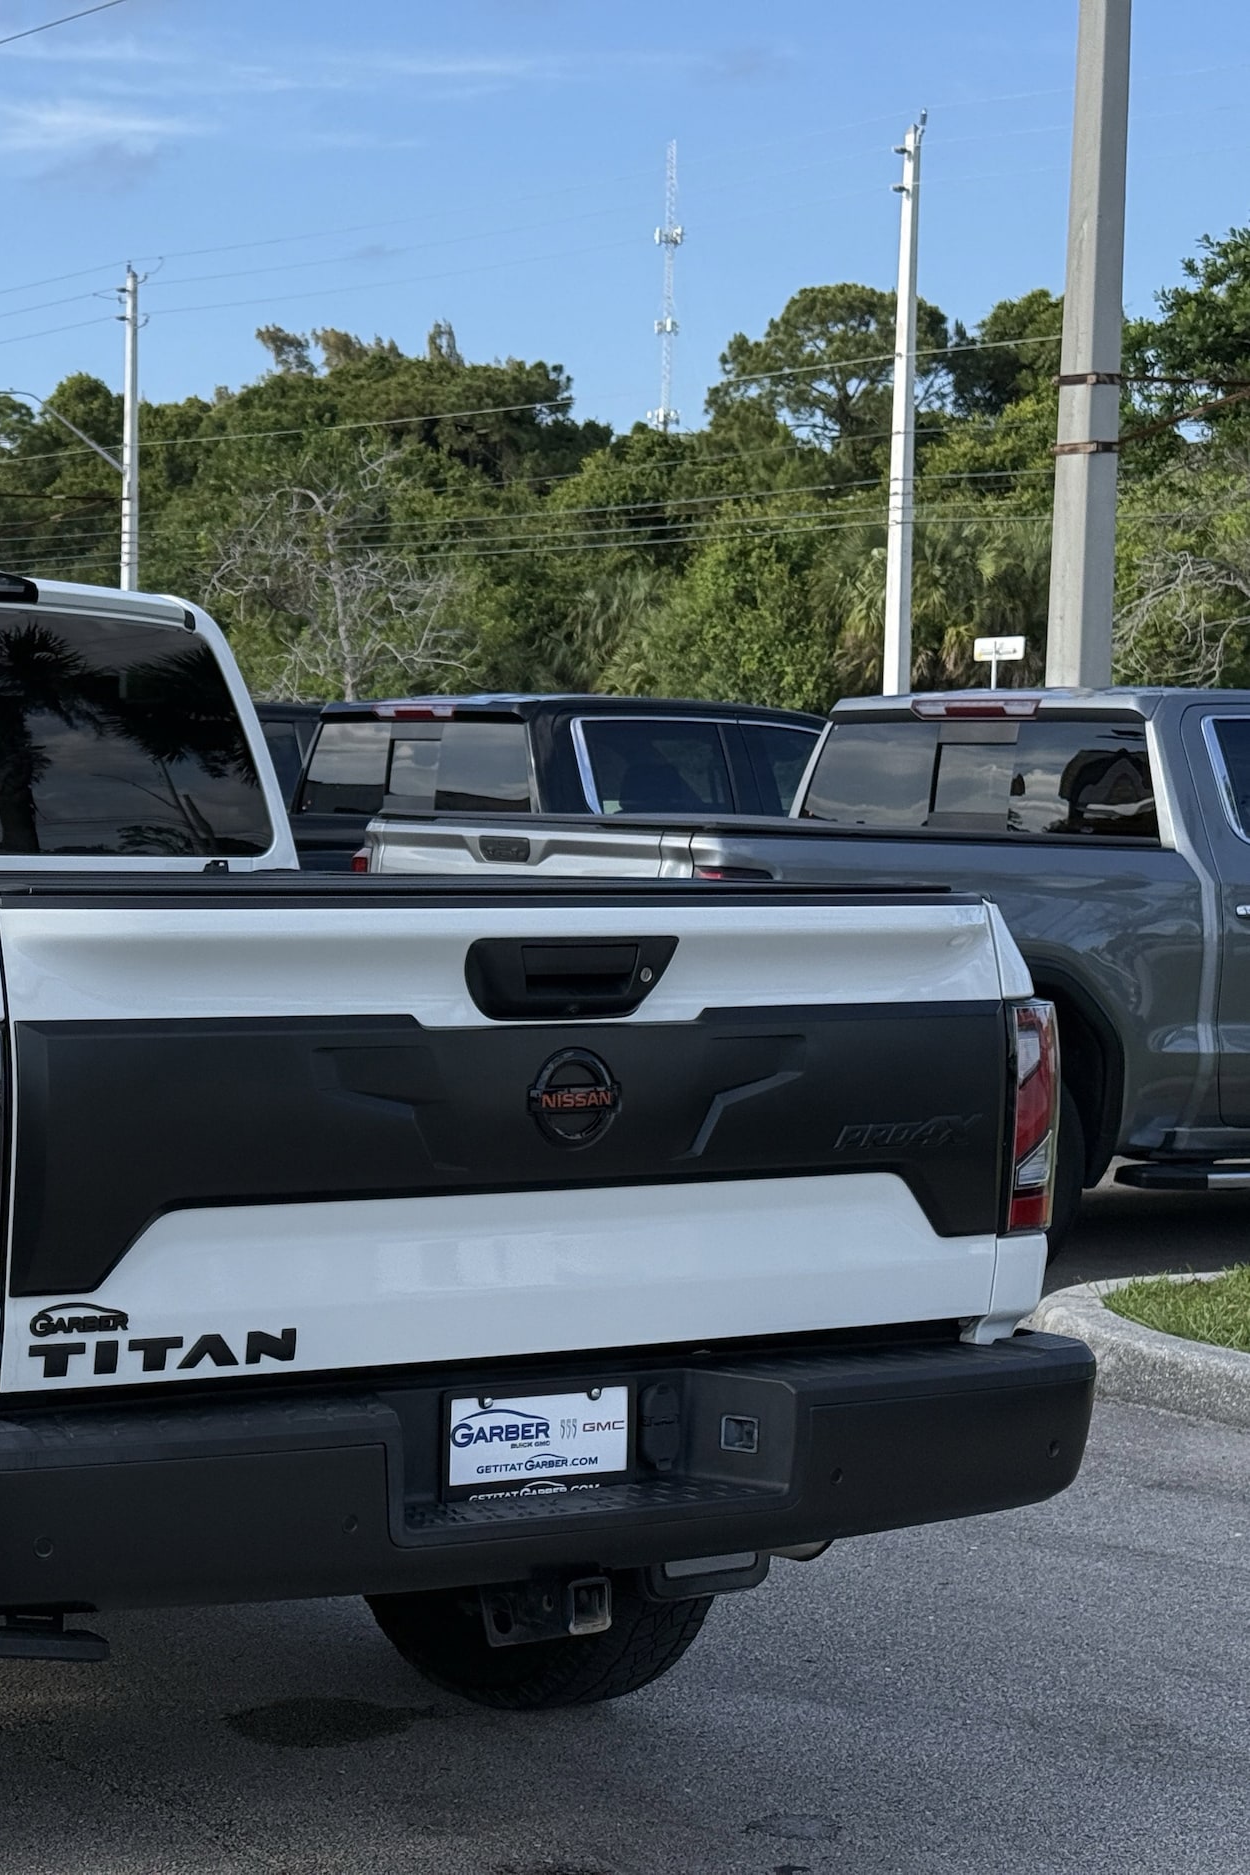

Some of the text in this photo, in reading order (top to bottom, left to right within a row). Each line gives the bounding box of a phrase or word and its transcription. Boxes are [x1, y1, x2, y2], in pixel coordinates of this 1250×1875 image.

[541, 1091, 613, 1108] NISSAN
[833, 1113, 984, 1150] PRO4X
[30, 1312, 129, 1338] GARBER
[29, 1328, 297, 1378] TITAN
[451, 1422, 550, 1449] GARBER
[582, 1420, 625, 1433] GMC
[476, 1456, 598, 1475] GETITATGARBER.COM
